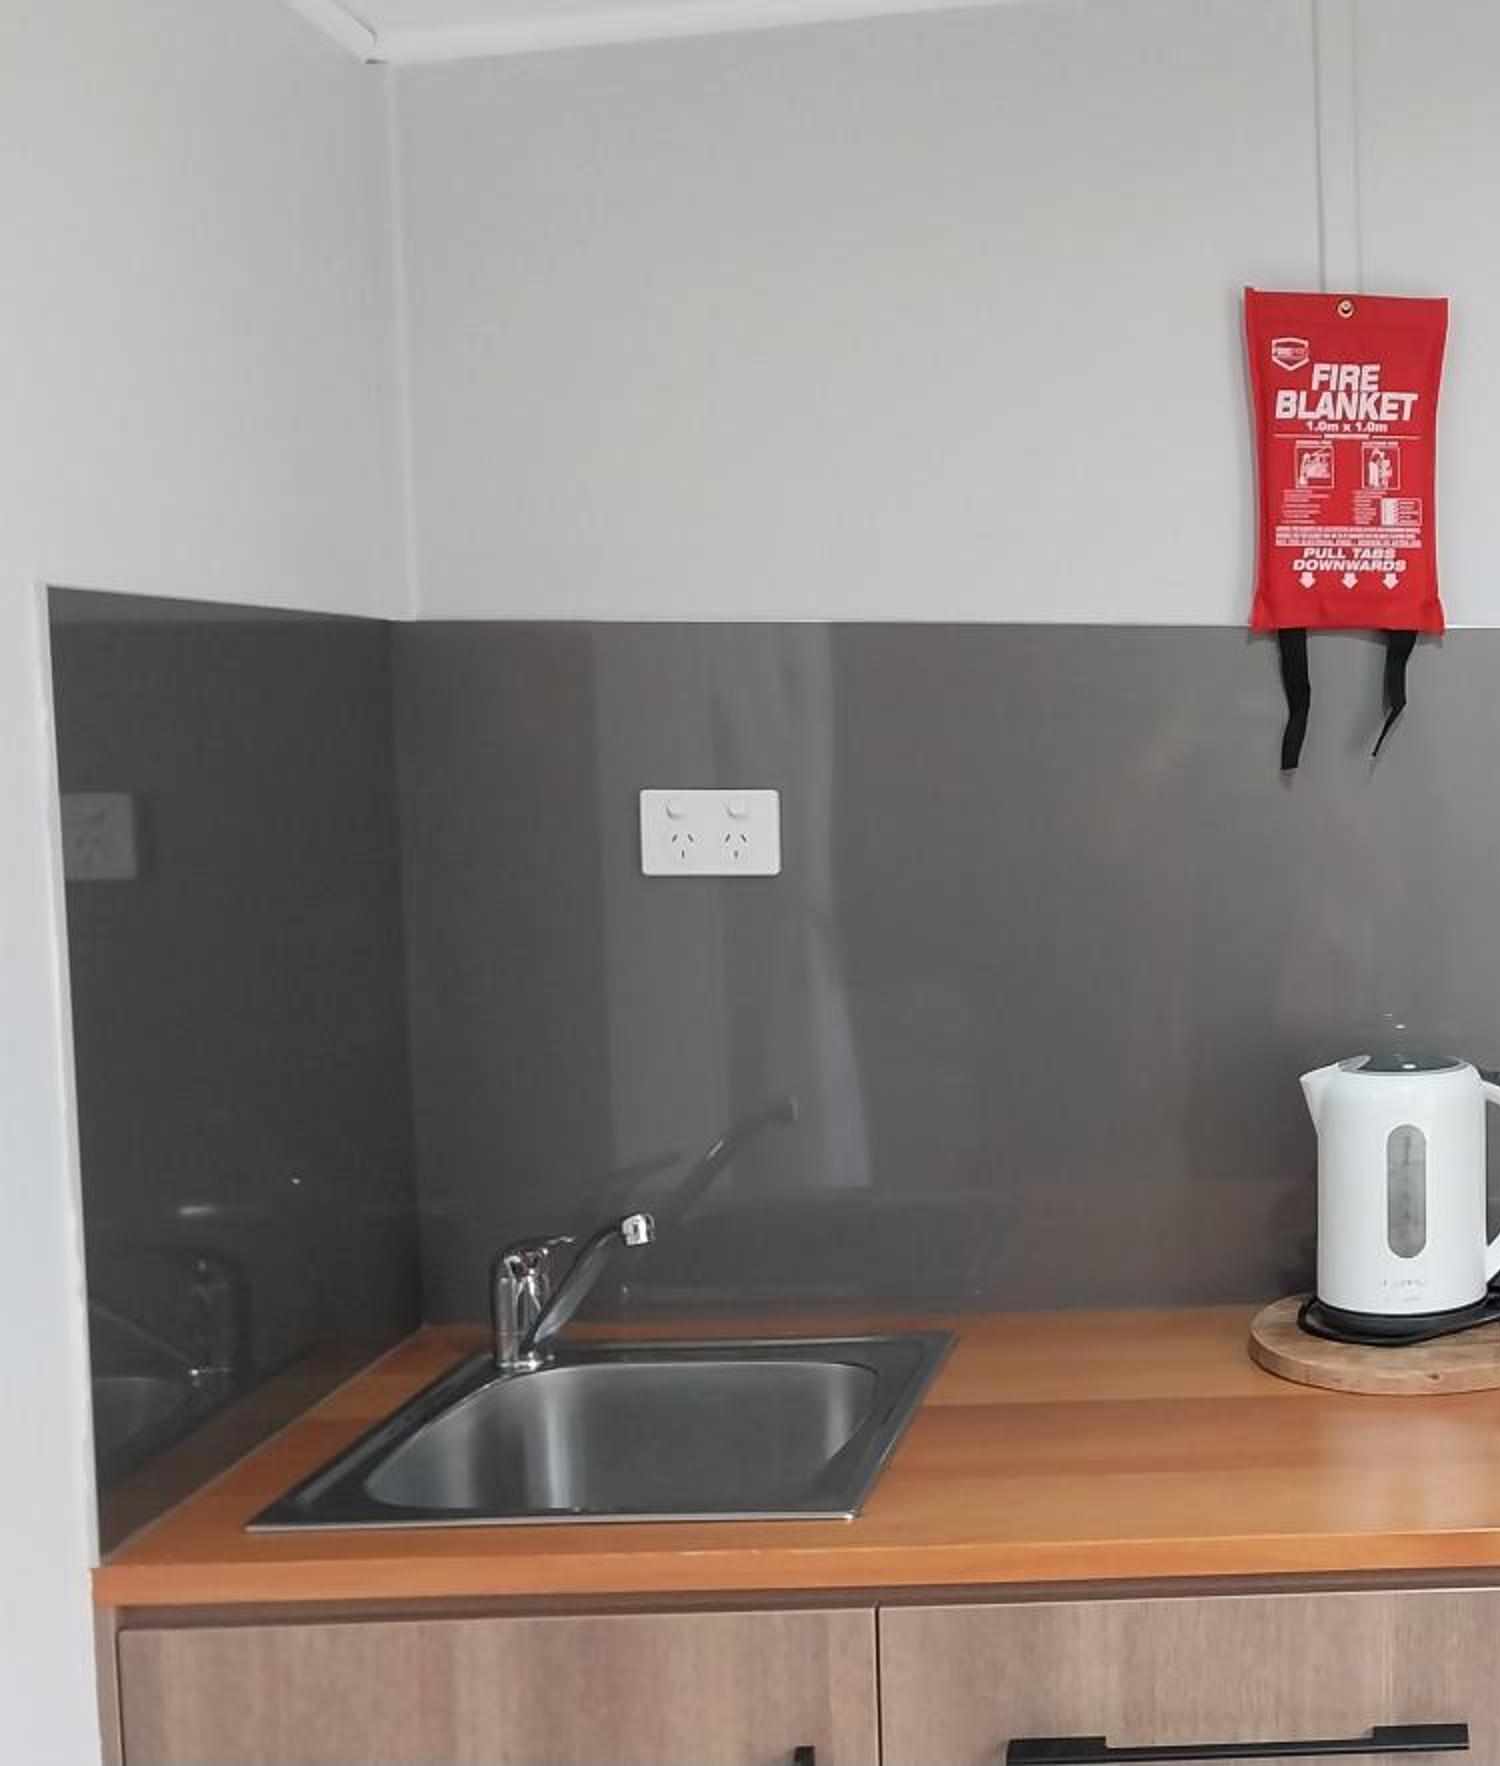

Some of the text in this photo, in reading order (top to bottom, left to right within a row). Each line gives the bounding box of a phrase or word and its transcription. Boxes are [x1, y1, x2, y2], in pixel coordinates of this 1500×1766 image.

[1311, 363, 1381, 391] FIRE
[1275, 389, 1419, 421] BLANKET
[1306, 421, 1388, 433] 1.0m x 1.0m
[1303, 547, 1396, 559] PULL TABS
[1293, 559, 1407, 571] DOWNWARDS
